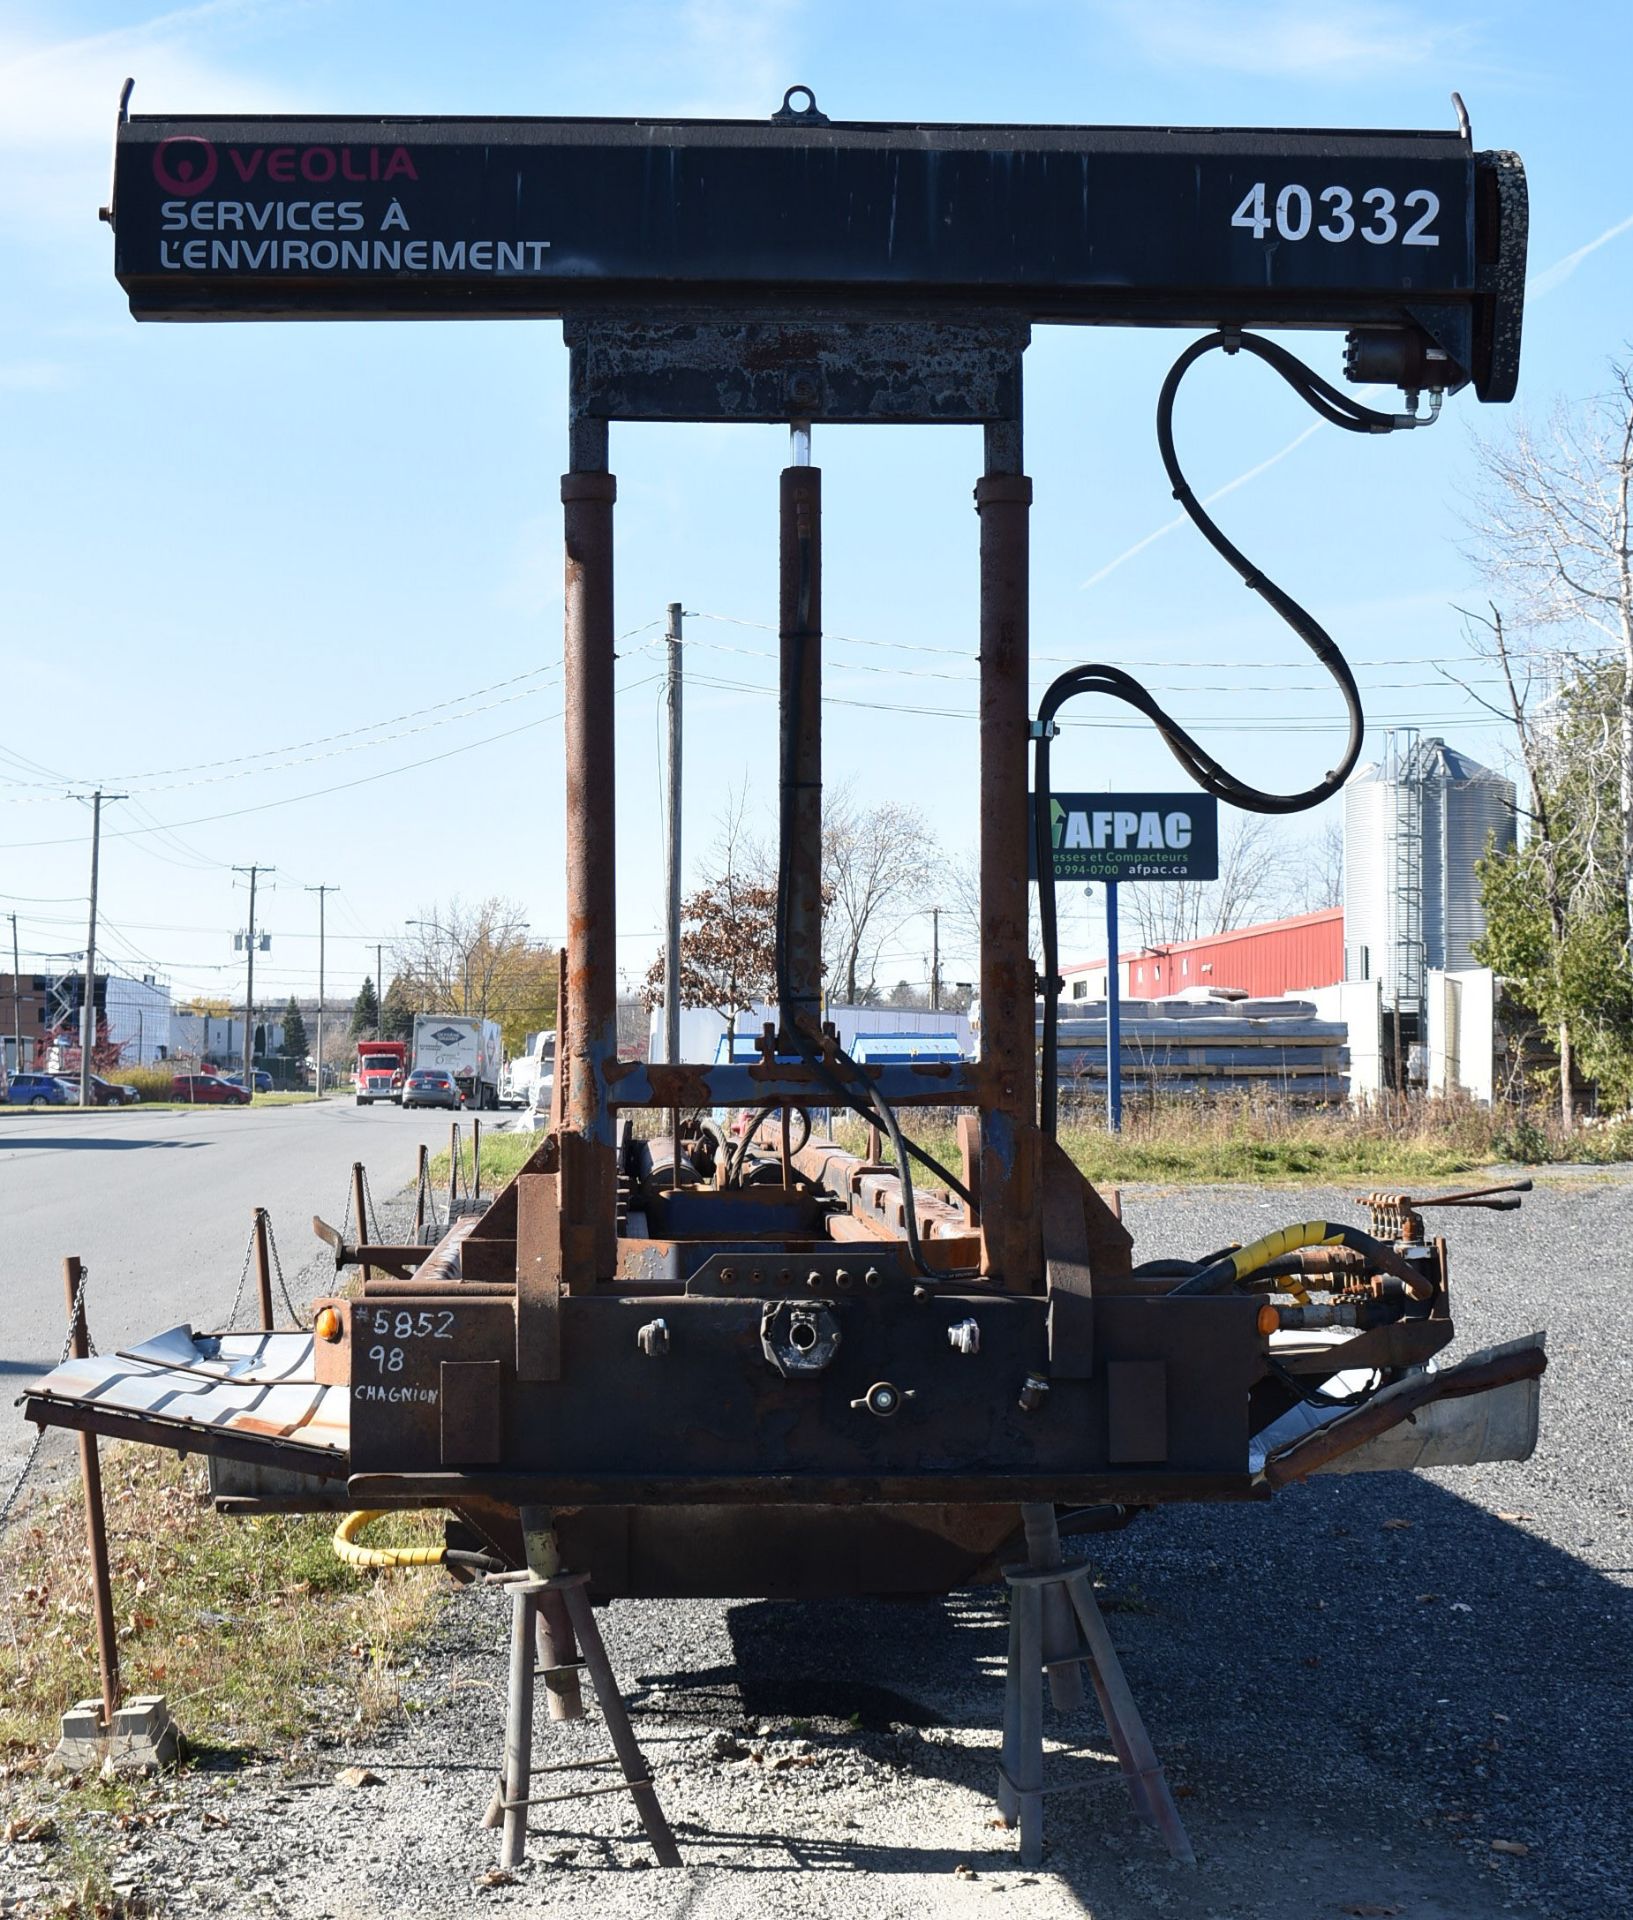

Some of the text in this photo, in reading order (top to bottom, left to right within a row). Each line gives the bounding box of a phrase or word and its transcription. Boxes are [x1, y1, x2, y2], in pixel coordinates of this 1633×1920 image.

[229, 147, 418, 182] VEOLIA
[161, 197, 410, 231] SERVICES À
[1231, 183, 1440, 246] 40332
[160, 240, 551, 271] L'ENVIRONNEMENT
[1064, 811, 1192, 849] AFPAC
[1053, 852, 1188, 864] esses et Compacteurs
[1064, 865, 1119, 875] 994-0700
[1128, 864, 1188, 876] afpac.ca
[369, 1345, 404, 1374] 98
